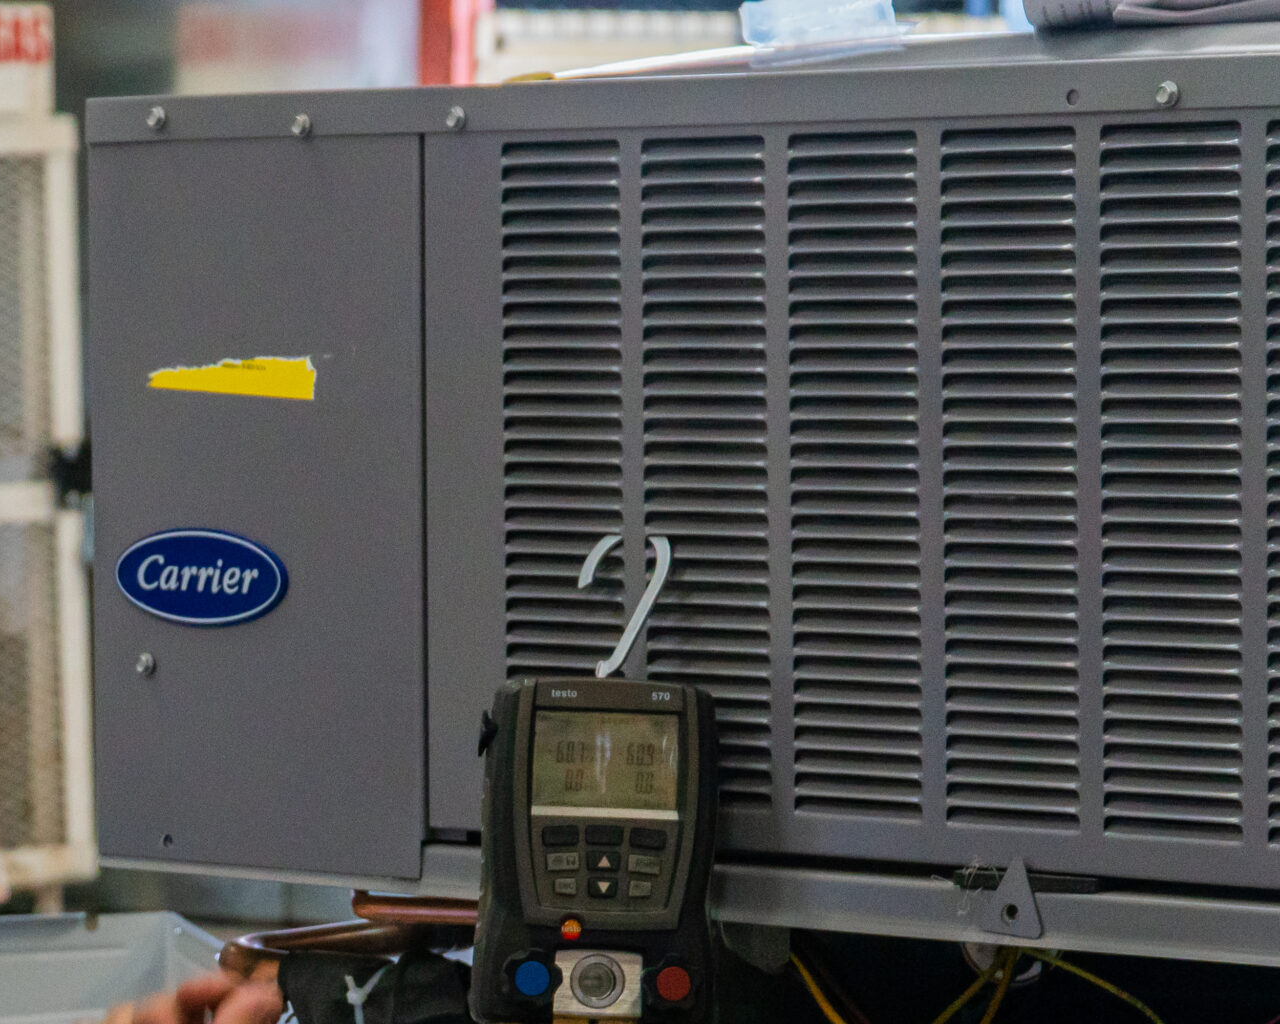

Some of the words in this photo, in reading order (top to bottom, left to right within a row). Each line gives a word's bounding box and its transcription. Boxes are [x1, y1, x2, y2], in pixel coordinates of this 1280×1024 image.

[137, 553, 260, 595] Carrier
[551, 688, 578, 698] testo
[651, 691, 671, 701] 570
